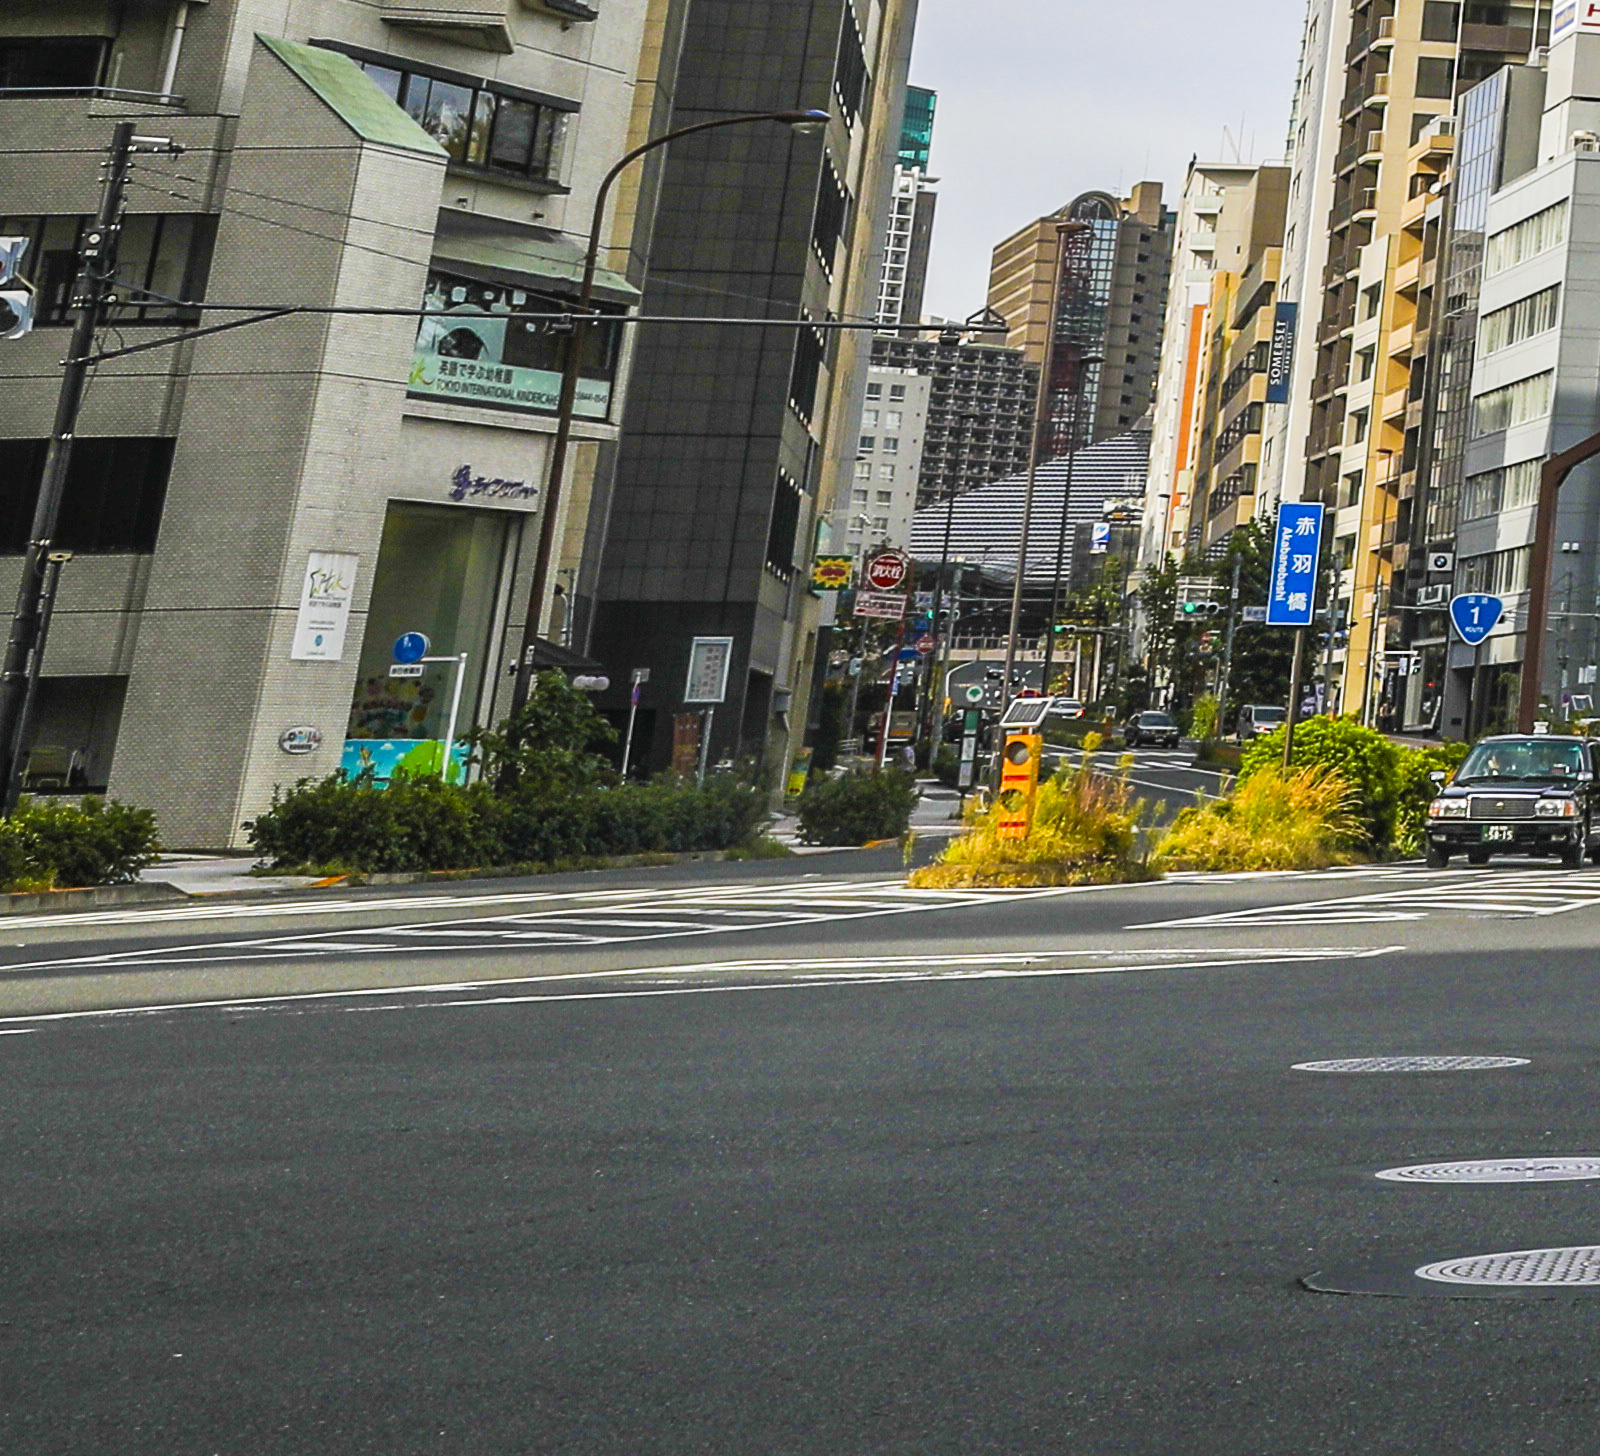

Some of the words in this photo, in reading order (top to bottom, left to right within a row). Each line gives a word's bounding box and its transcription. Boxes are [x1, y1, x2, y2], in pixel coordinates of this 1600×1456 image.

[1270, 320, 1286, 385] SOMERSET
[1275, 526, 1293, 602] Akabanebashi
[1287, 517, 1316, 612] 赤羽橋
[1470, 606, 1480, 624] 1
